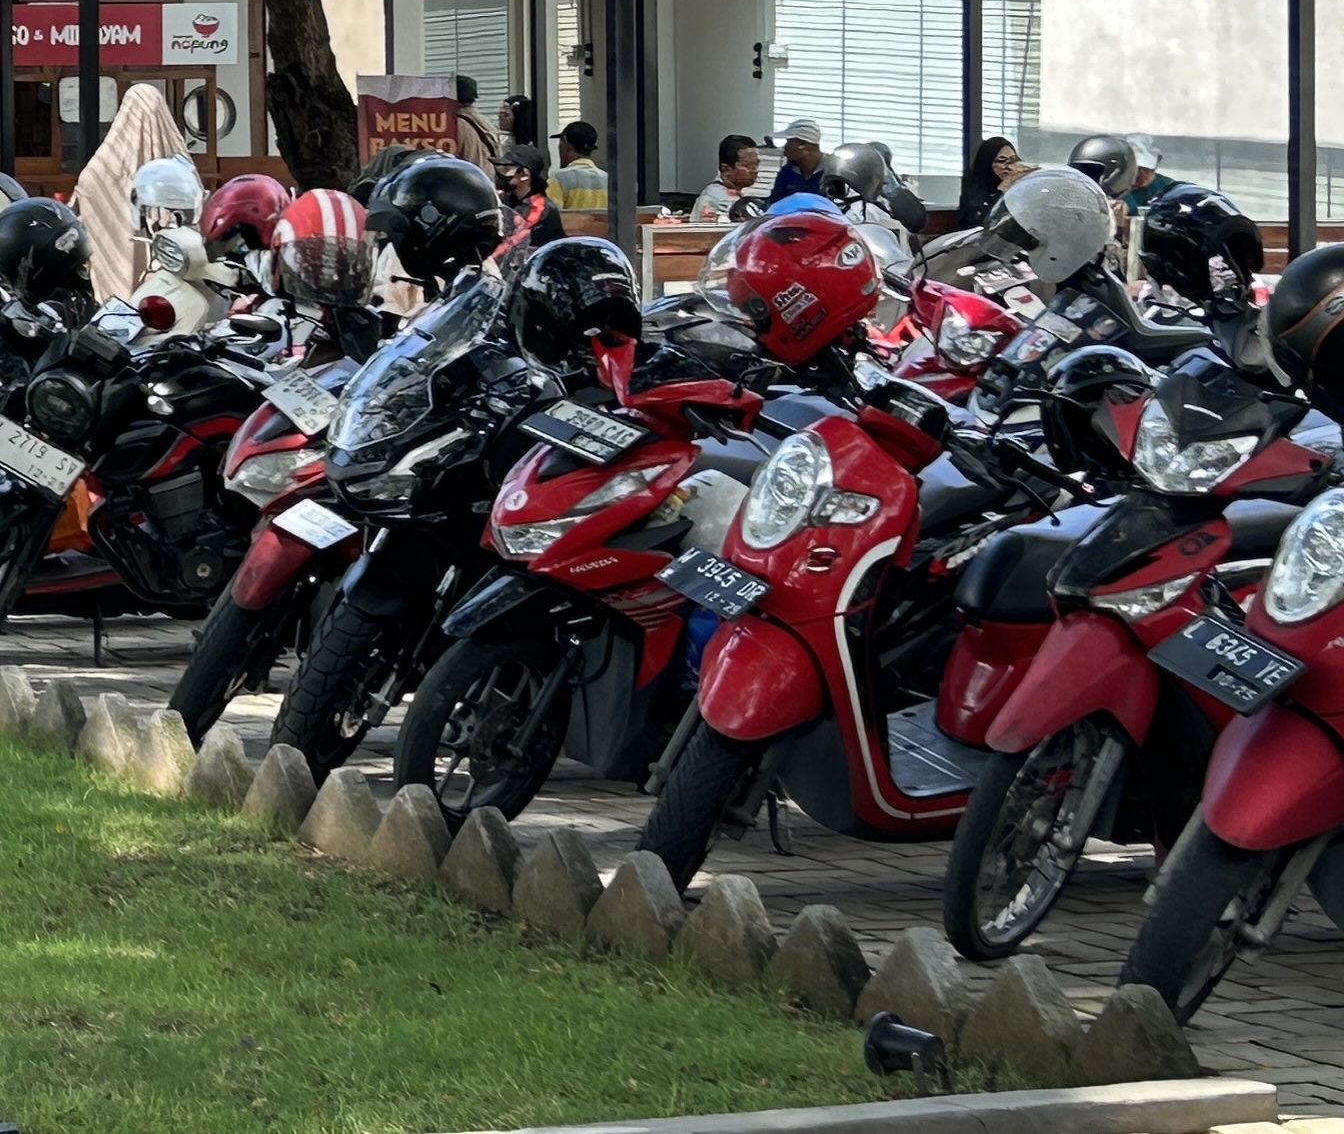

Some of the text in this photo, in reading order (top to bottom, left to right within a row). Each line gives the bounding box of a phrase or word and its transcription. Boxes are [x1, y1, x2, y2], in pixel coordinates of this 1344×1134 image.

[375, 112, 448, 133] MENU
[677, 546, 701, 564] W
[697, 557, 743, 588] 3945
[1182, 619, 1206, 640] L
[1254, 659, 1291, 686] YE
